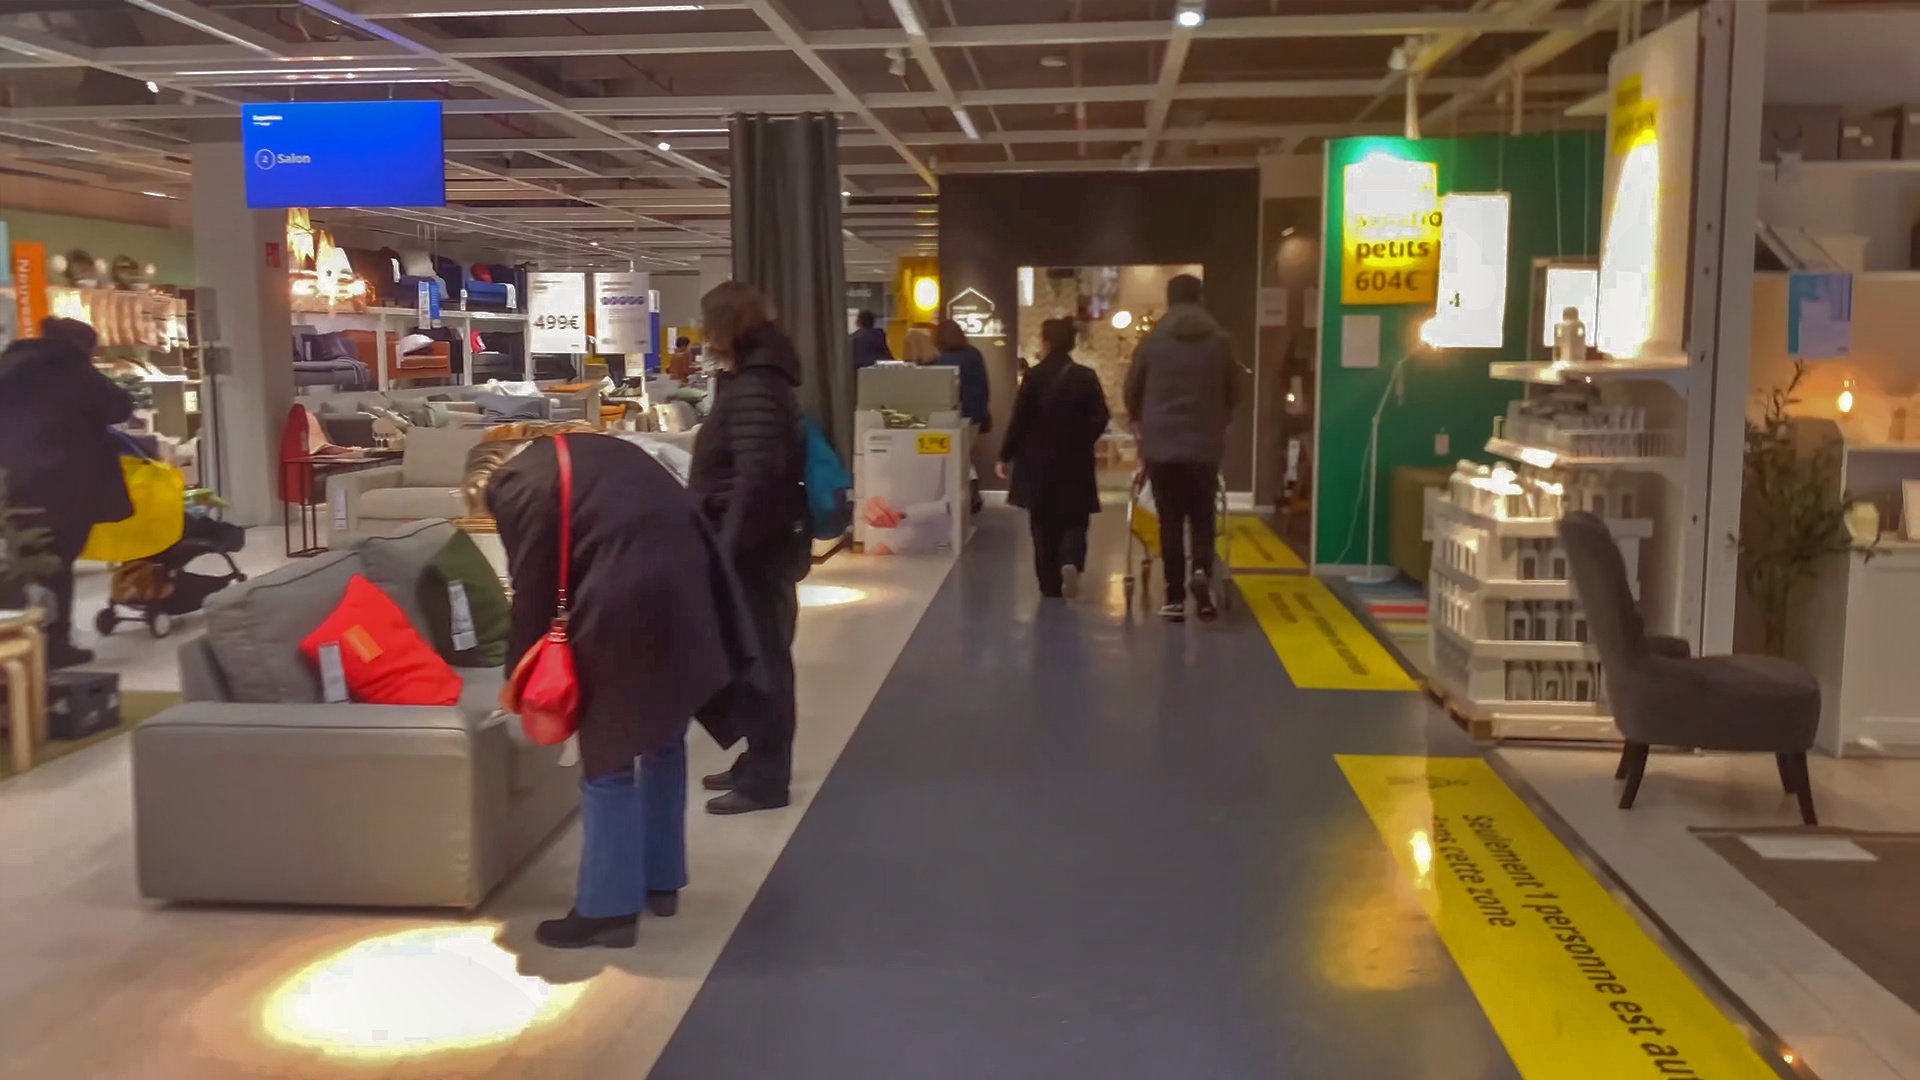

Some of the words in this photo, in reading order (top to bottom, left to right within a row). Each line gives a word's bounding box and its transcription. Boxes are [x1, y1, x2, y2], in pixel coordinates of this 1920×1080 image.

[277, 153, 311, 164] Salon
[1356, 241, 1431, 264] petits
[533, 315, 580, 330] 499€
[1439, 846, 1486, 884] cette
[1465, 887, 1517, 928] zone
[1462, 814, 1545, 888] Seulement
[1521, 904, 1628, 995] personne
[1609, 1001, 1667, 1036] est
[1640, 1042, 1706, 1080] au
